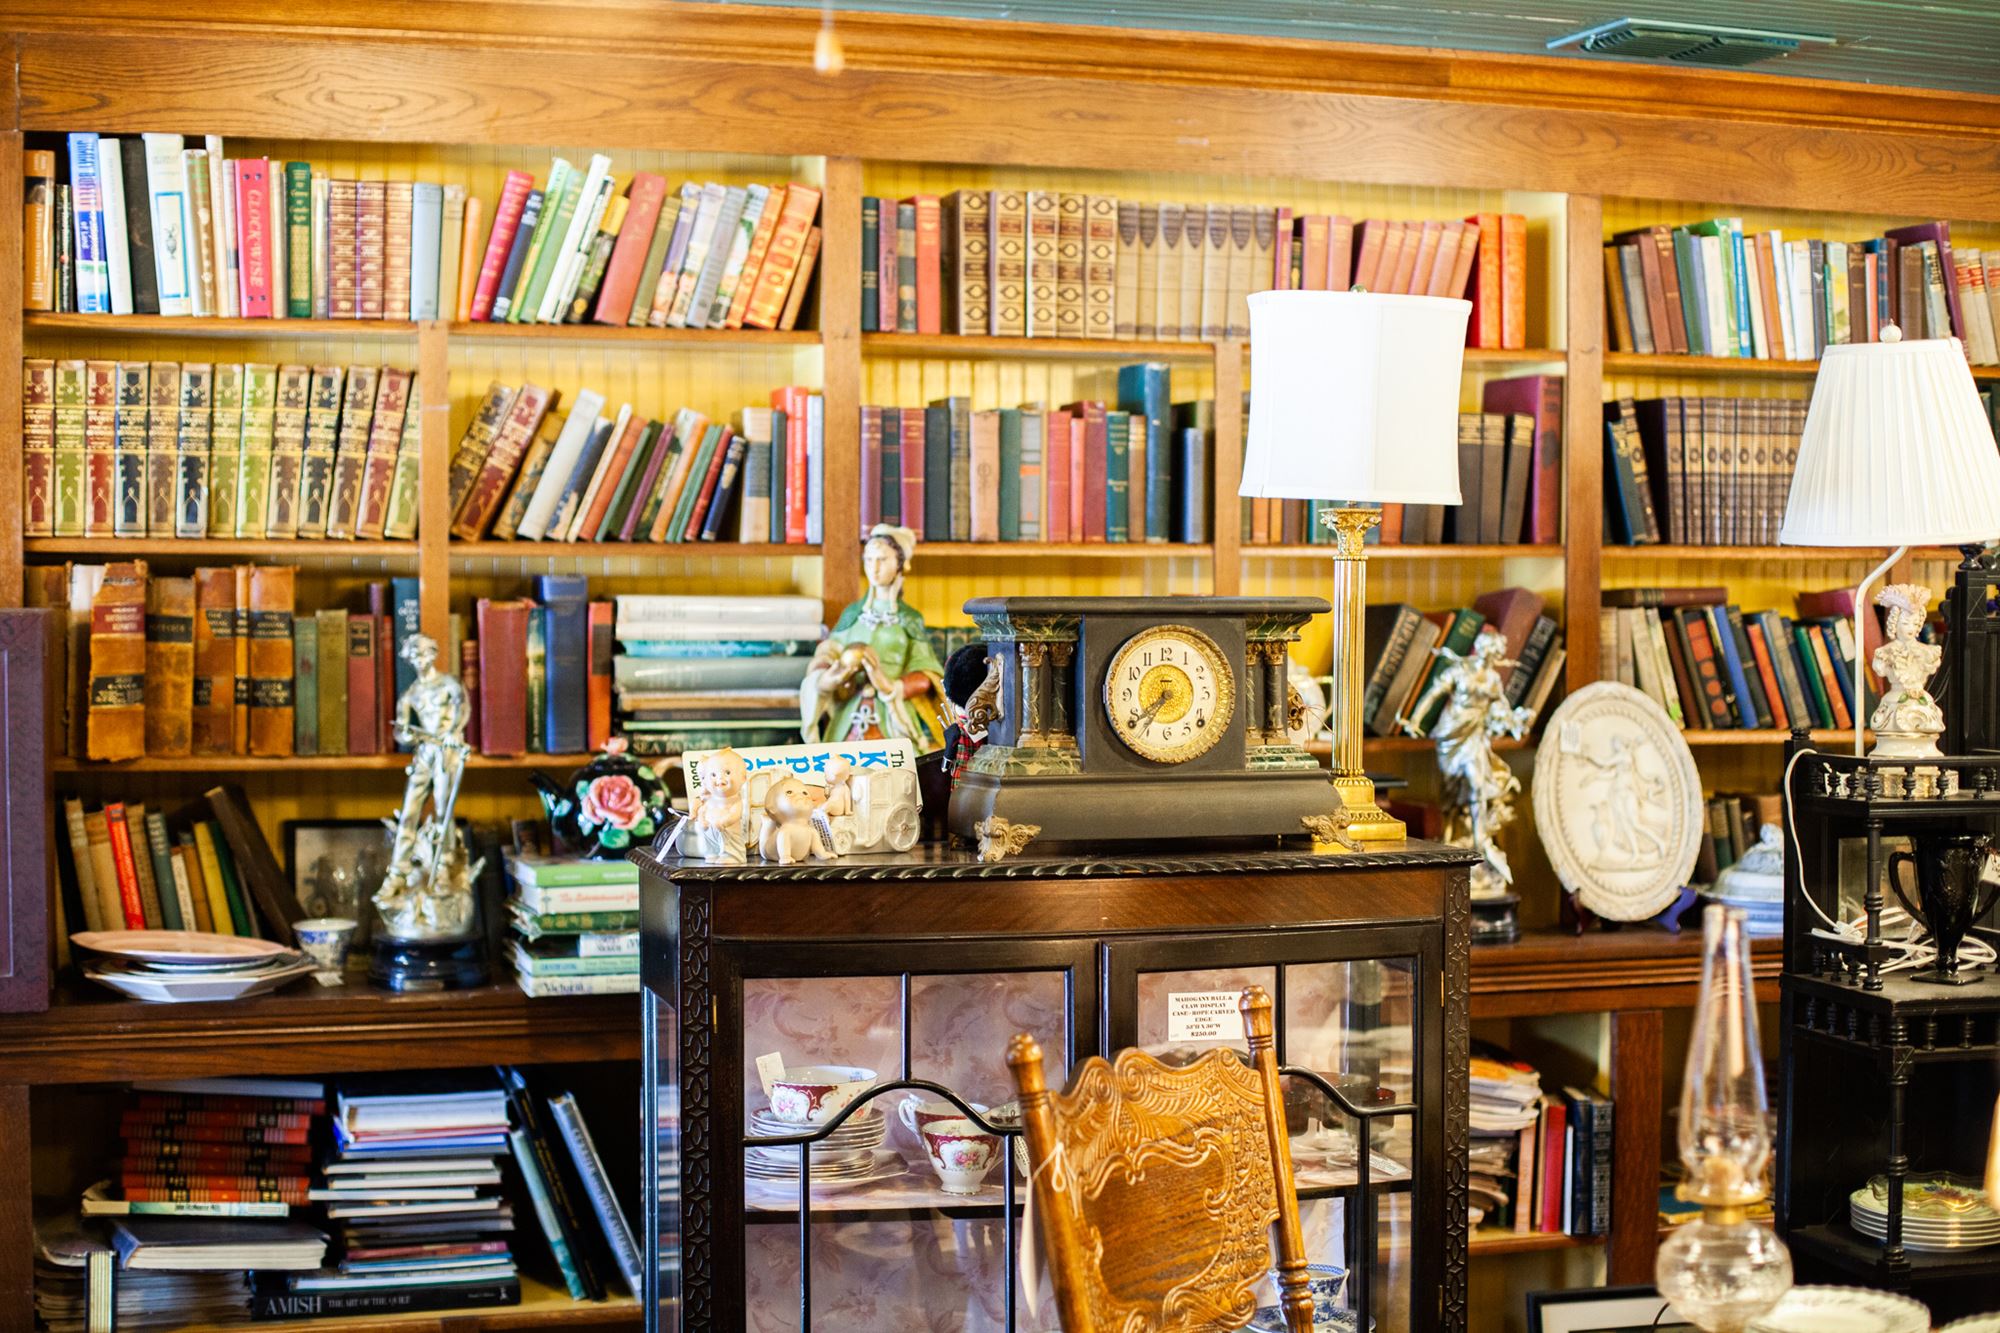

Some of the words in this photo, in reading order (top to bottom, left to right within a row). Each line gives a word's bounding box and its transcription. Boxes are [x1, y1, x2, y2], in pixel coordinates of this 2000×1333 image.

[77, 140, 95, 169] JIMMY
[78, 172, 97, 206] BUFFETT
[1143, 653, 1152, 666] 11
[1160, 647, 1173, 661] 12
[1183, 652, 1189, 665] 1
[1129, 666, 1141, 680] 10
[1196, 666, 1205, 680] 2
[1122, 688, 1132, 701] 9
[1202, 687, 1211, 700] 3
[1130, 709, 1139, 721] 8
[1196, 709, 1204, 719] 4
[1163, 727, 1172, 740] 6
[1182, 723, 1191, 736] 5
[890, 750, 905, 768] Th
[265, 1296, 322, 1315] AMISH
